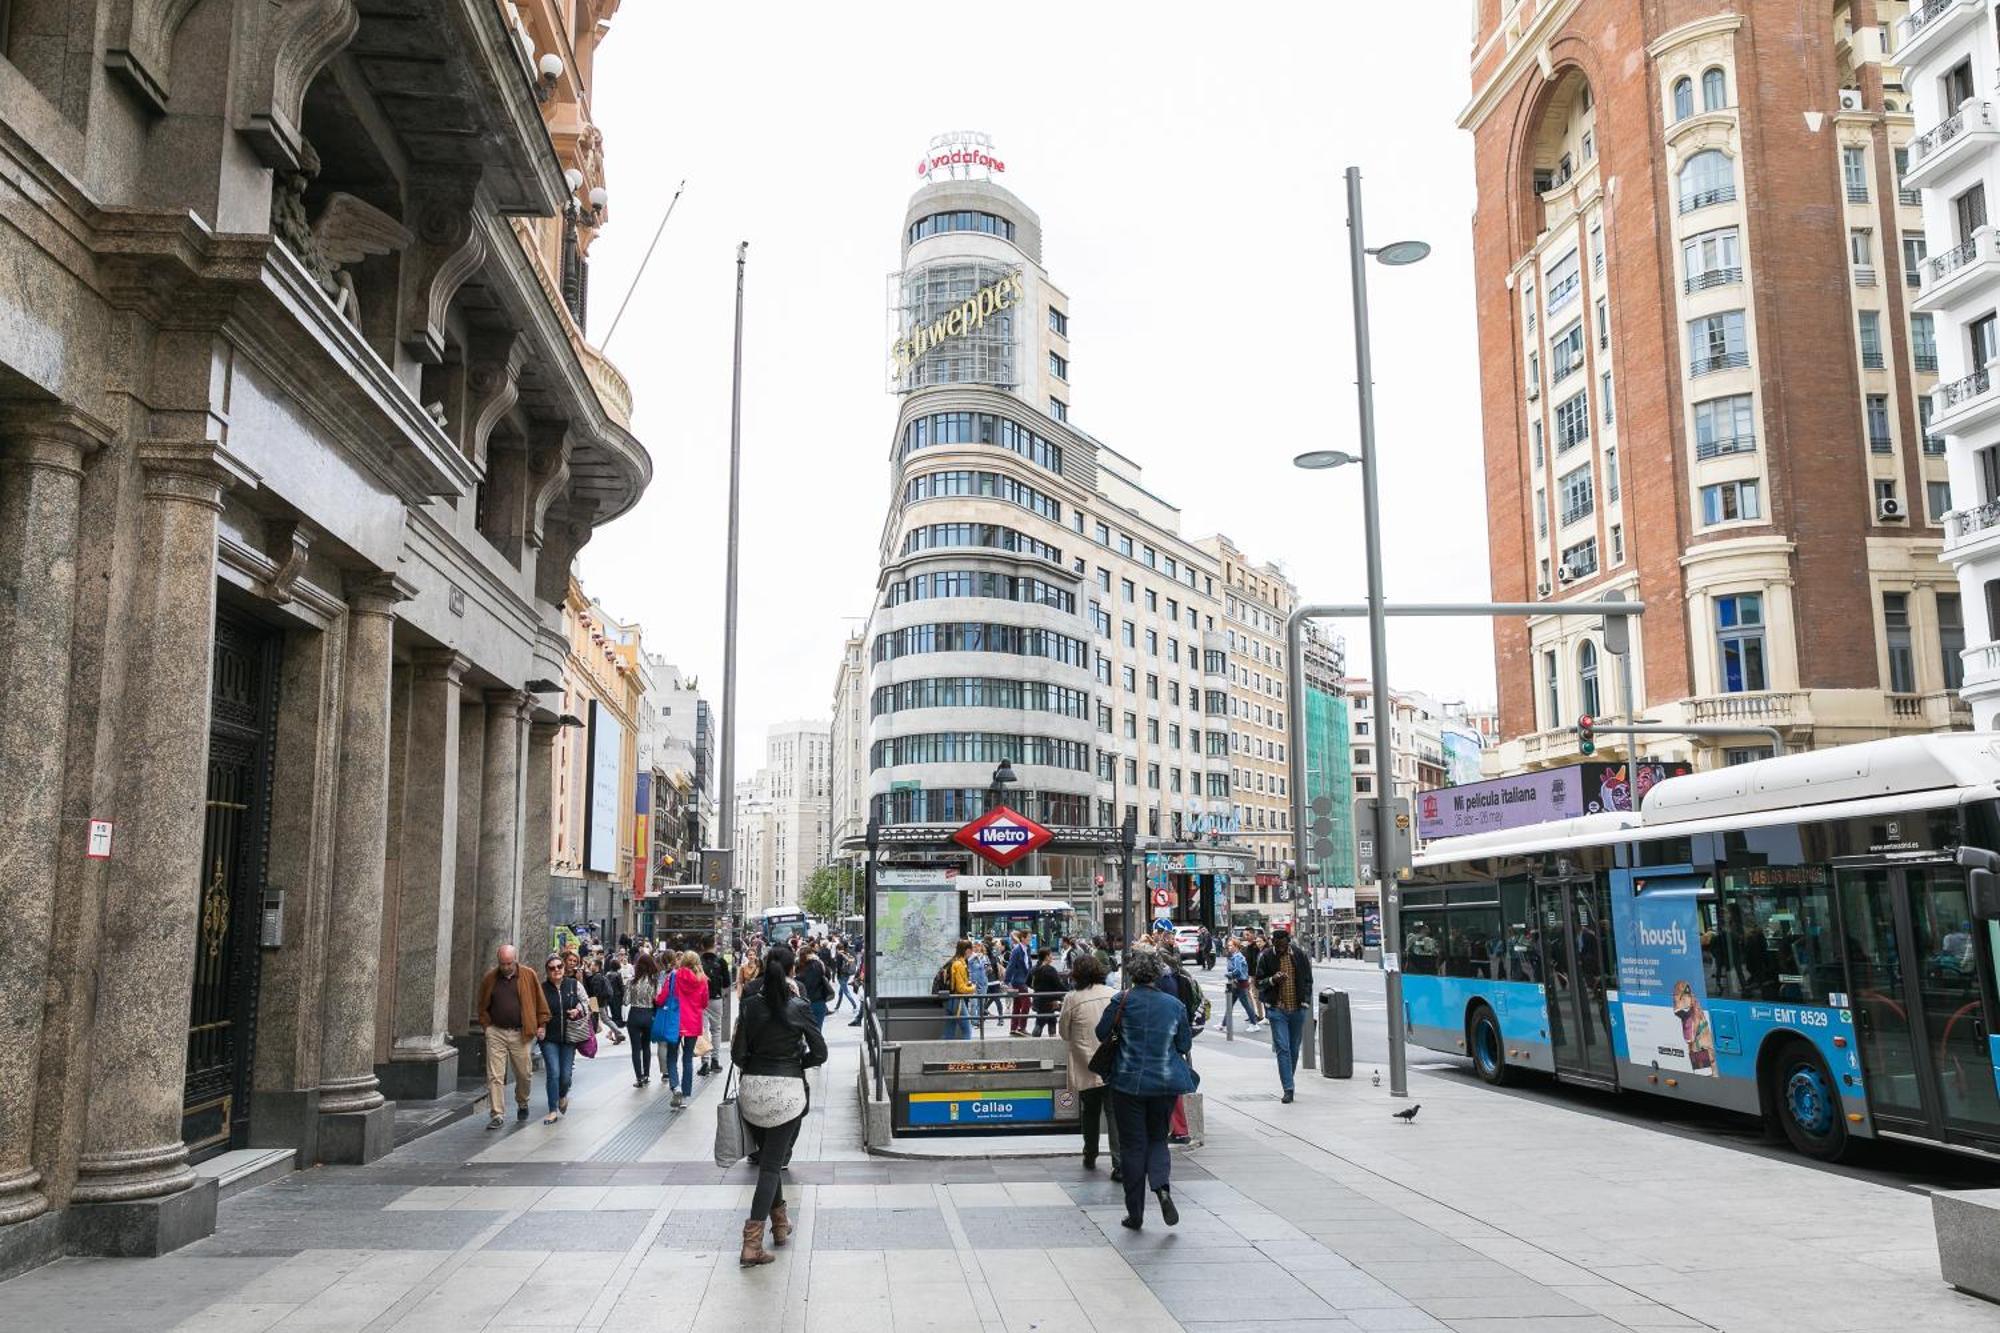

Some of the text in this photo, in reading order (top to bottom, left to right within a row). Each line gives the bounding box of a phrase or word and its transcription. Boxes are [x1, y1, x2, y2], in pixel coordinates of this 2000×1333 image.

[932, 149, 1005, 173] vodafone
[891, 268, 1025, 381] Schweppes
[1454, 796, 1464, 811] Mi
[1466, 790, 1499, 812] película
[1501, 786, 1536, 804] italiana
[982, 828, 1025, 843] Metro
[985, 878, 1022, 888] Callao
[1639, 920, 1687, 954] housfy
[1774, 1008, 1797, 1025] EMT
[1800, 1010, 1828, 1027] 8529
[972, 1101, 1013, 1113] Callao
